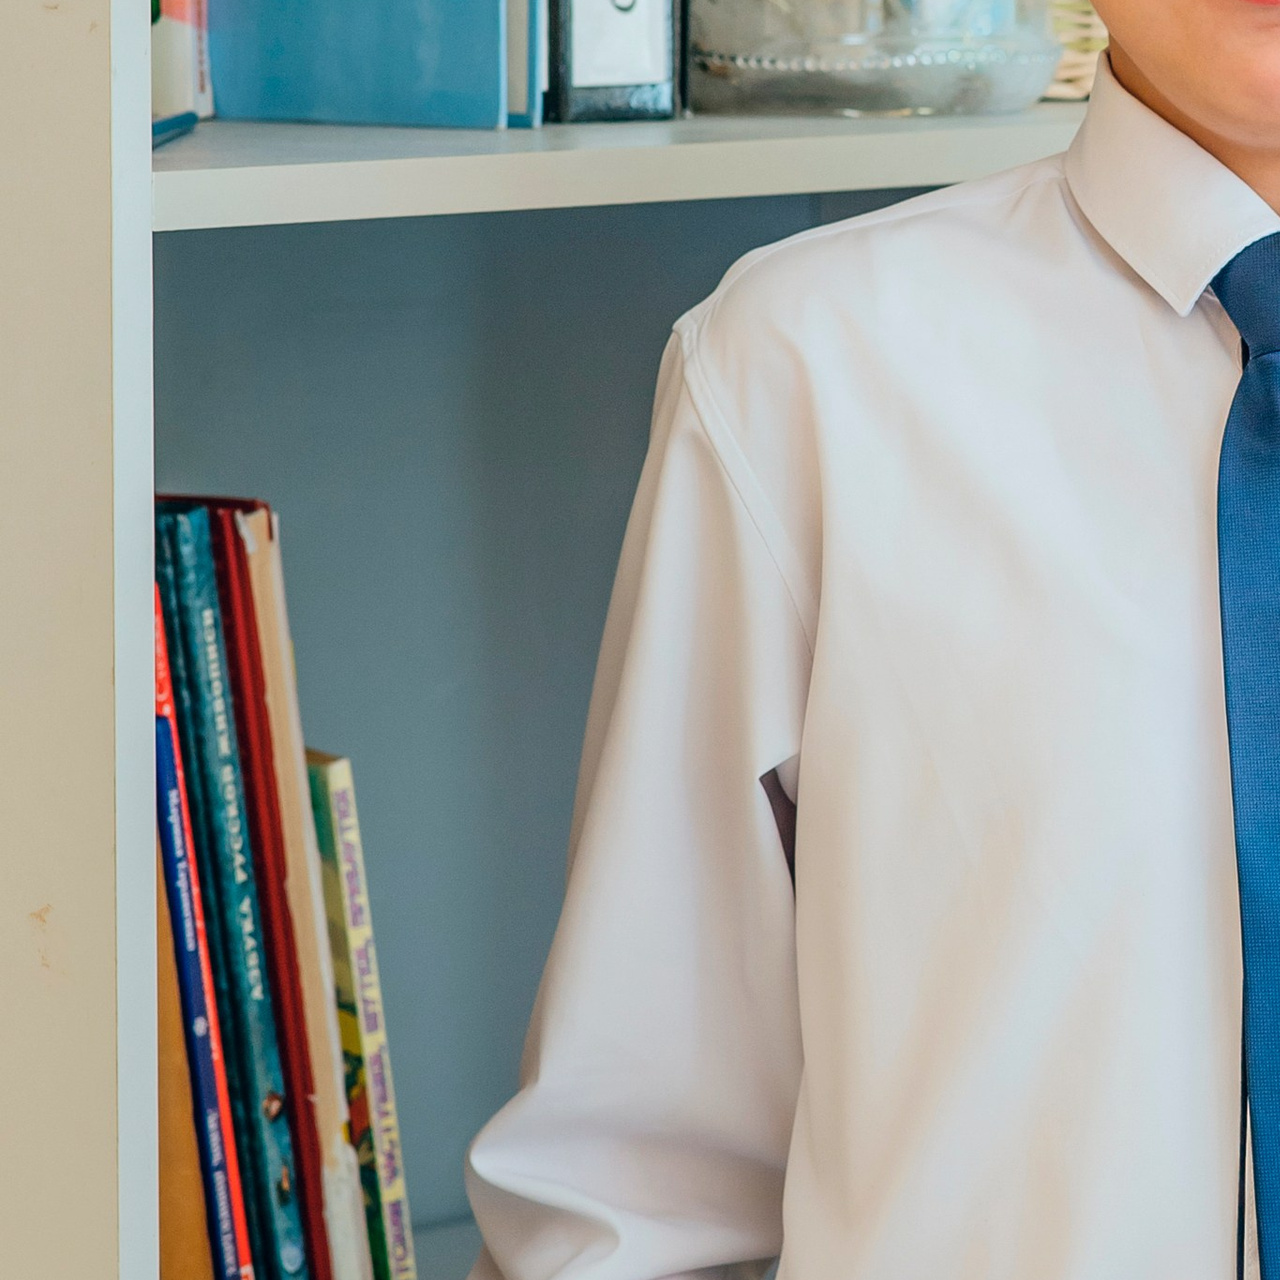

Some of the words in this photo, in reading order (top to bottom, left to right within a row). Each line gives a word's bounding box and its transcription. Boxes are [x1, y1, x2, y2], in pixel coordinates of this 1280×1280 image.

[201, 609, 231, 756] ЖИВОПИСИ
[222, 765, 248, 882] РУССКОЙ
[239, 896, 264, 1000] АЗБУКА
